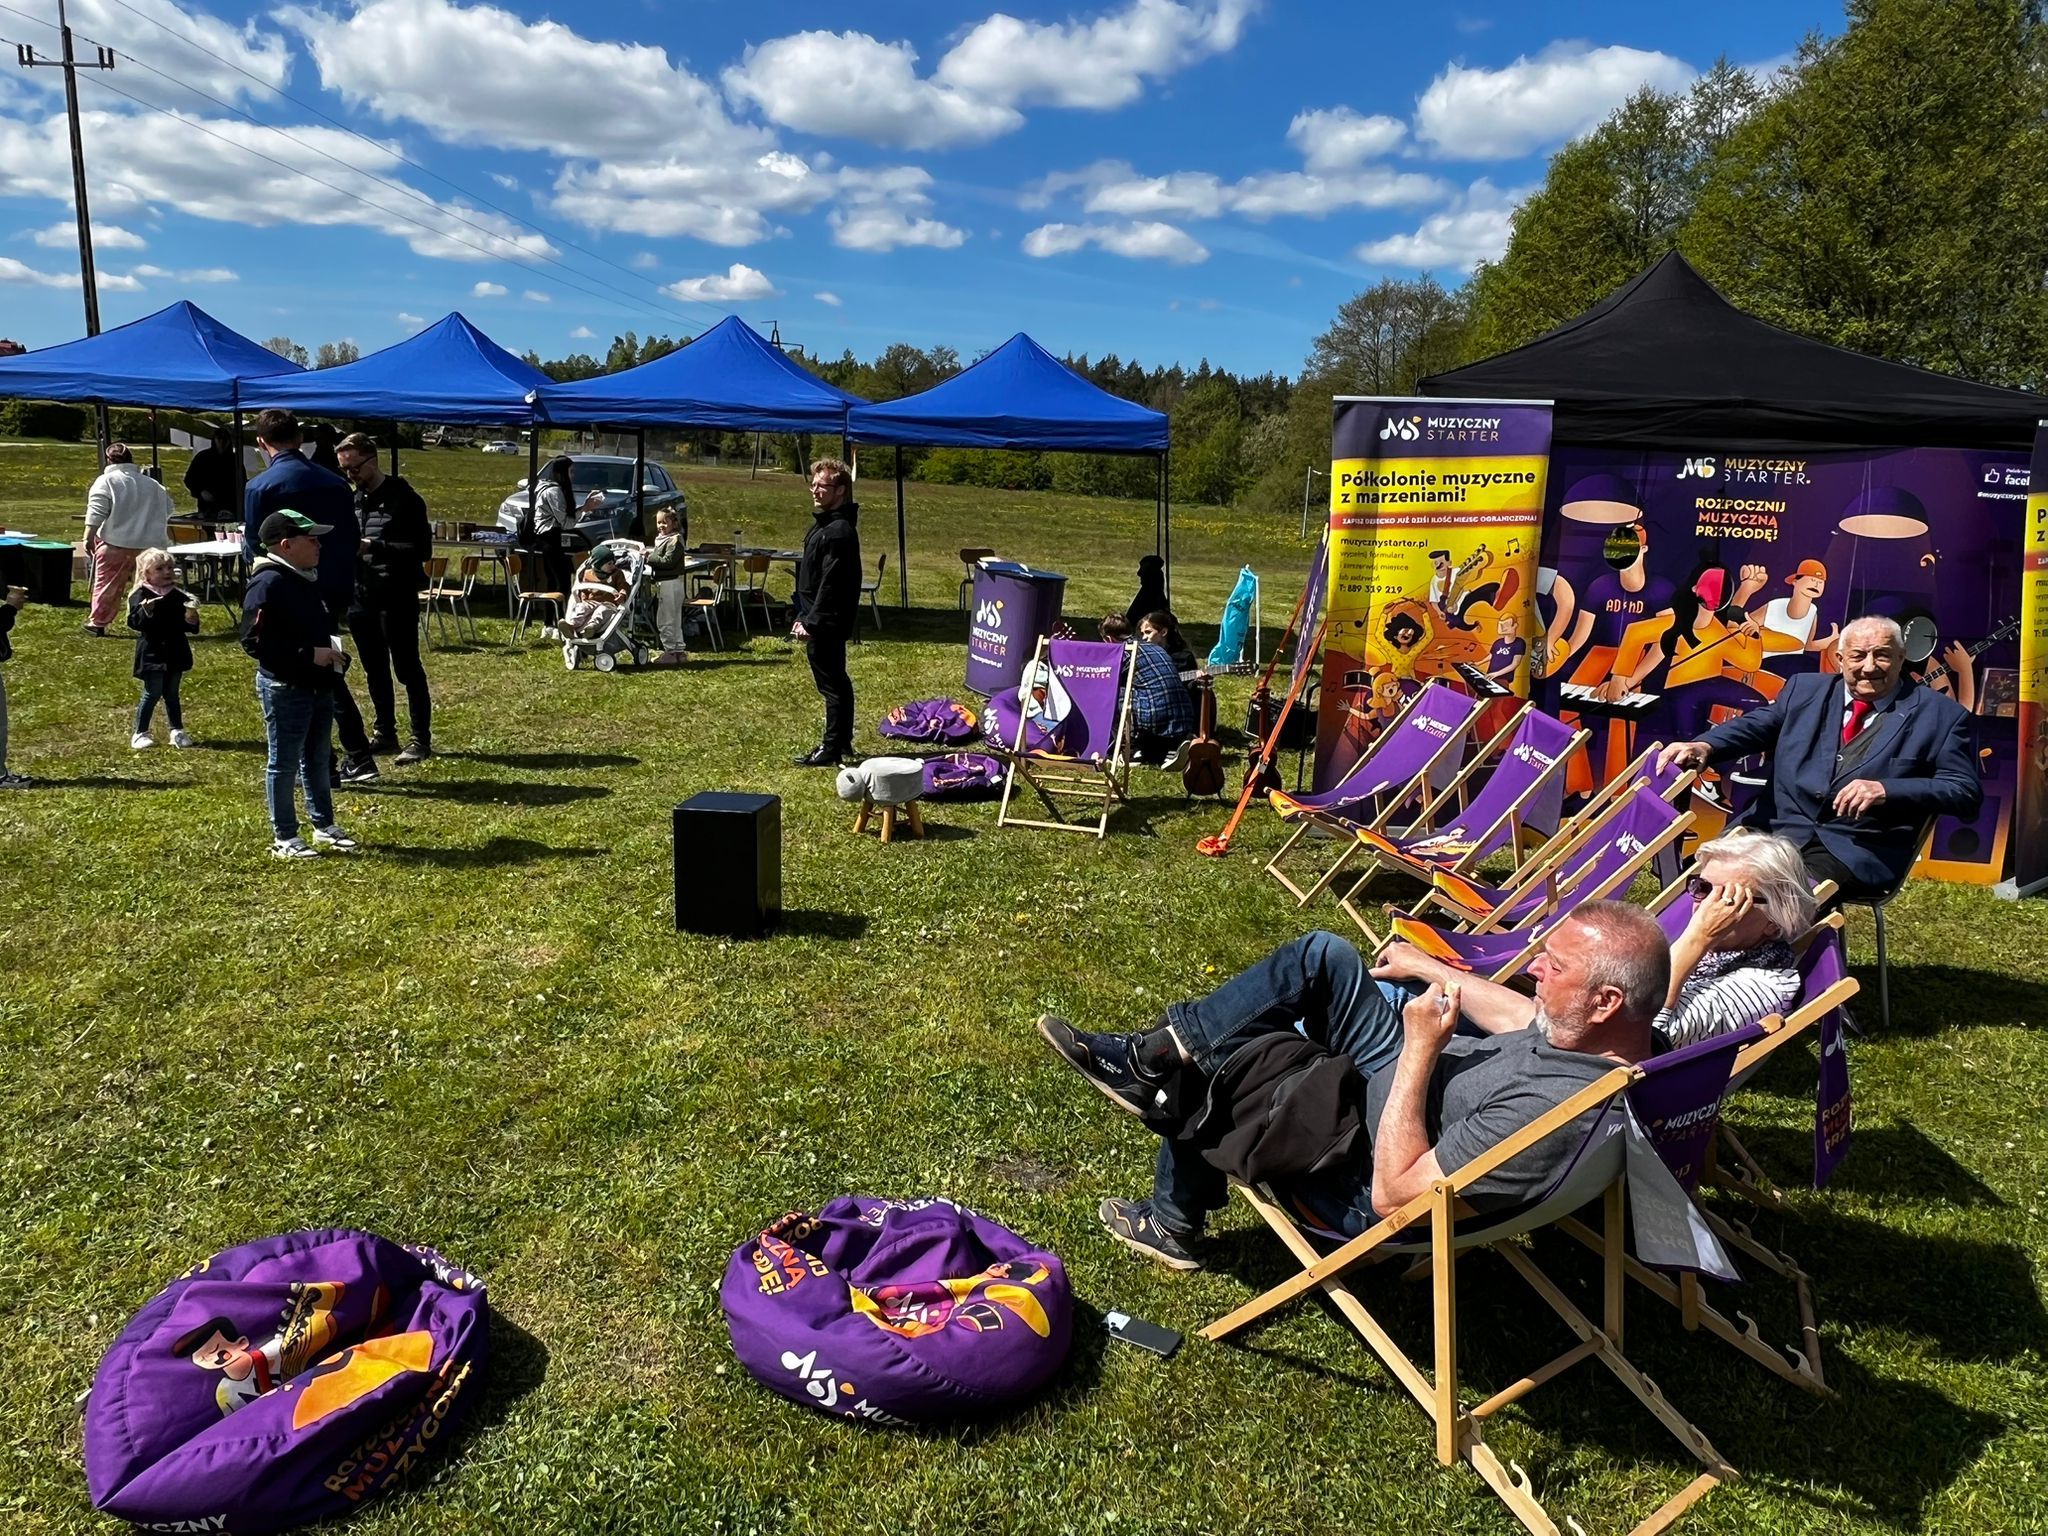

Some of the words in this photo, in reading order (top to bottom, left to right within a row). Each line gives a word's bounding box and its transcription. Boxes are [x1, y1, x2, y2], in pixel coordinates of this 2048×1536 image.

[1428, 417, 1500, 429] MUZYCZNY
[1427, 430, 1498, 441] STARTER
[1724, 458, 1806, 472] MUZYCZNY
[1341, 470, 1437, 487] Półkolonie
[1442, 472, 1536, 488] muzyczne
[1341, 492, 1350, 504] z
[1356, 487, 1466, 504] marzeniami!
[1695, 497, 1786, 513] ROZPOCZNIJ
[1698, 512, 1778, 529] MUZYCZNĄ
[1695, 525, 1778, 542] PRZYGODĘ!
[1340, 538, 1428, 549] muzycznystarter.pl
[1365, 585, 1382, 593] 319
[1385, 585, 1403, 594] 219
